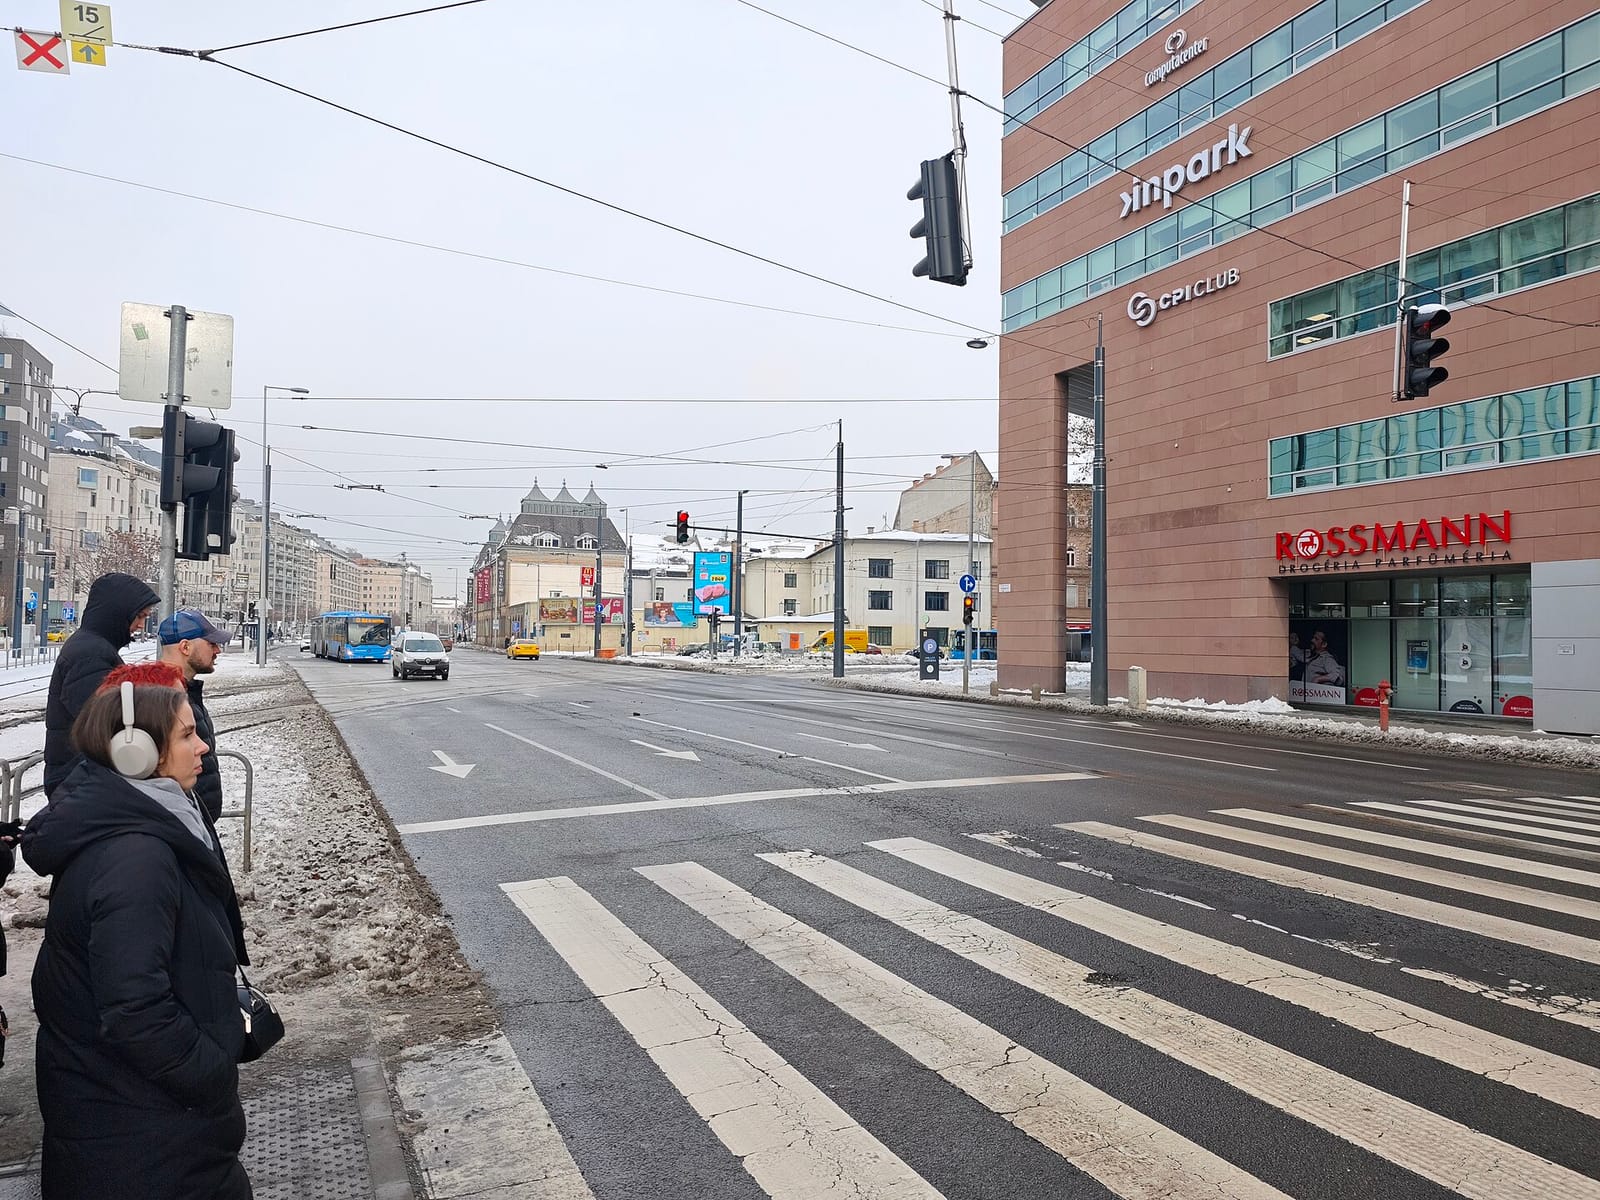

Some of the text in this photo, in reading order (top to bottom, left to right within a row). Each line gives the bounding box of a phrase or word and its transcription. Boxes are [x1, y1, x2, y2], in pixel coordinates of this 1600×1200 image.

[74, 5, 99, 23] 15
[1144, 36, 1210, 87] Computacenter
[1159, 268, 1240, 309] CPI CLUB
[1275, 510, 1511, 561] ROSSMANN
[1279, 549, 1511, 574] DROGÉRIA PARFÜMÉRIA
[1292, 688, 1341, 698] ROSSMANN
